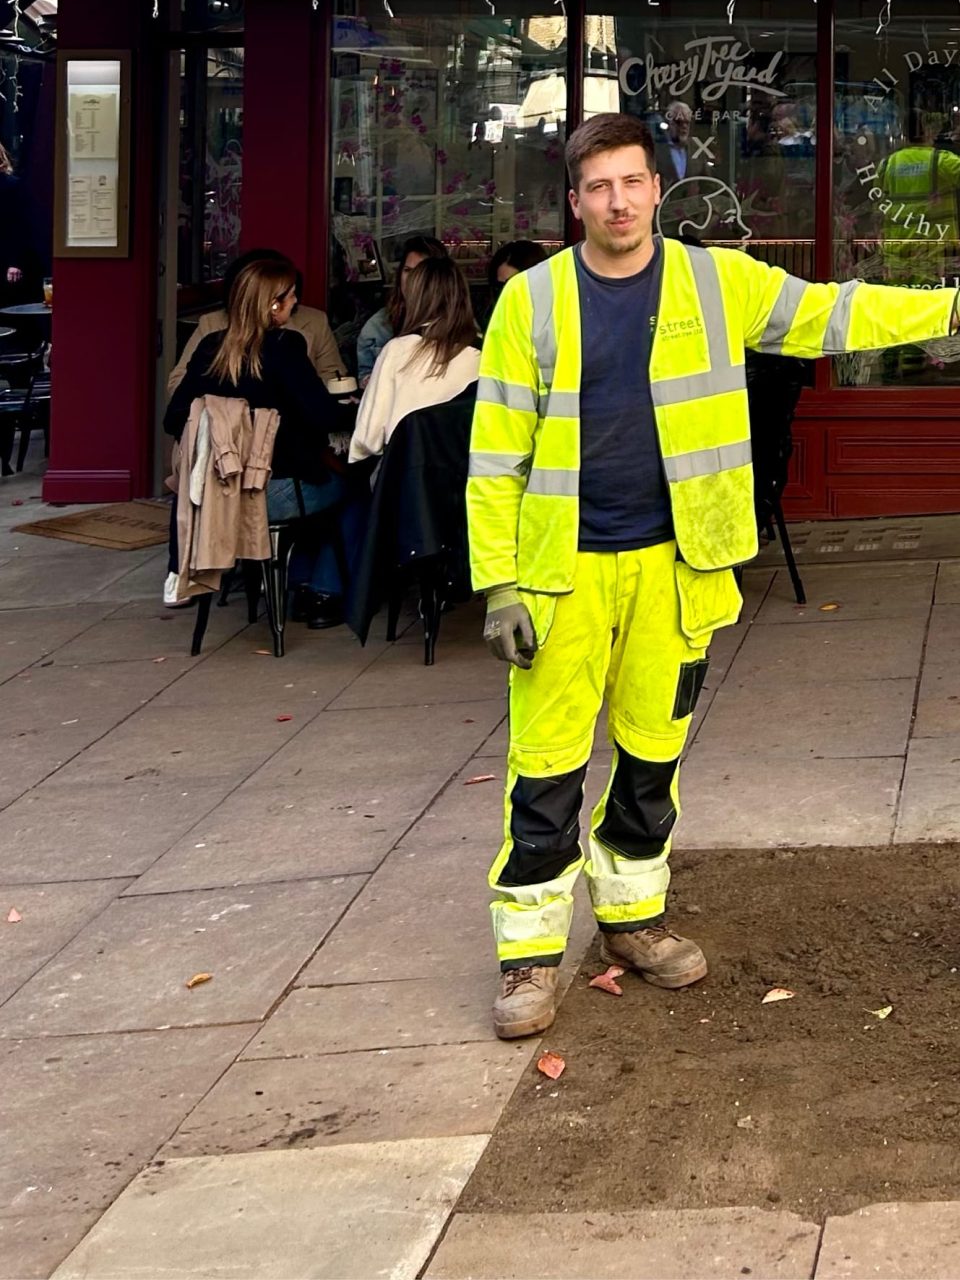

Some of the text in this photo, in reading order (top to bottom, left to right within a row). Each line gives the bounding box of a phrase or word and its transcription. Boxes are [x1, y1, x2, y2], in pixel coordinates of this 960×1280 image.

[618, 35, 753, 99] Cherry Tree
[863, 67, 899, 113] All
[903, 48, 960, 73] Day
[665, 107, 740, 121] CAFÉ BAR
[855, 161, 950, 241] Healthy
[658, 316, 702, 335] street
